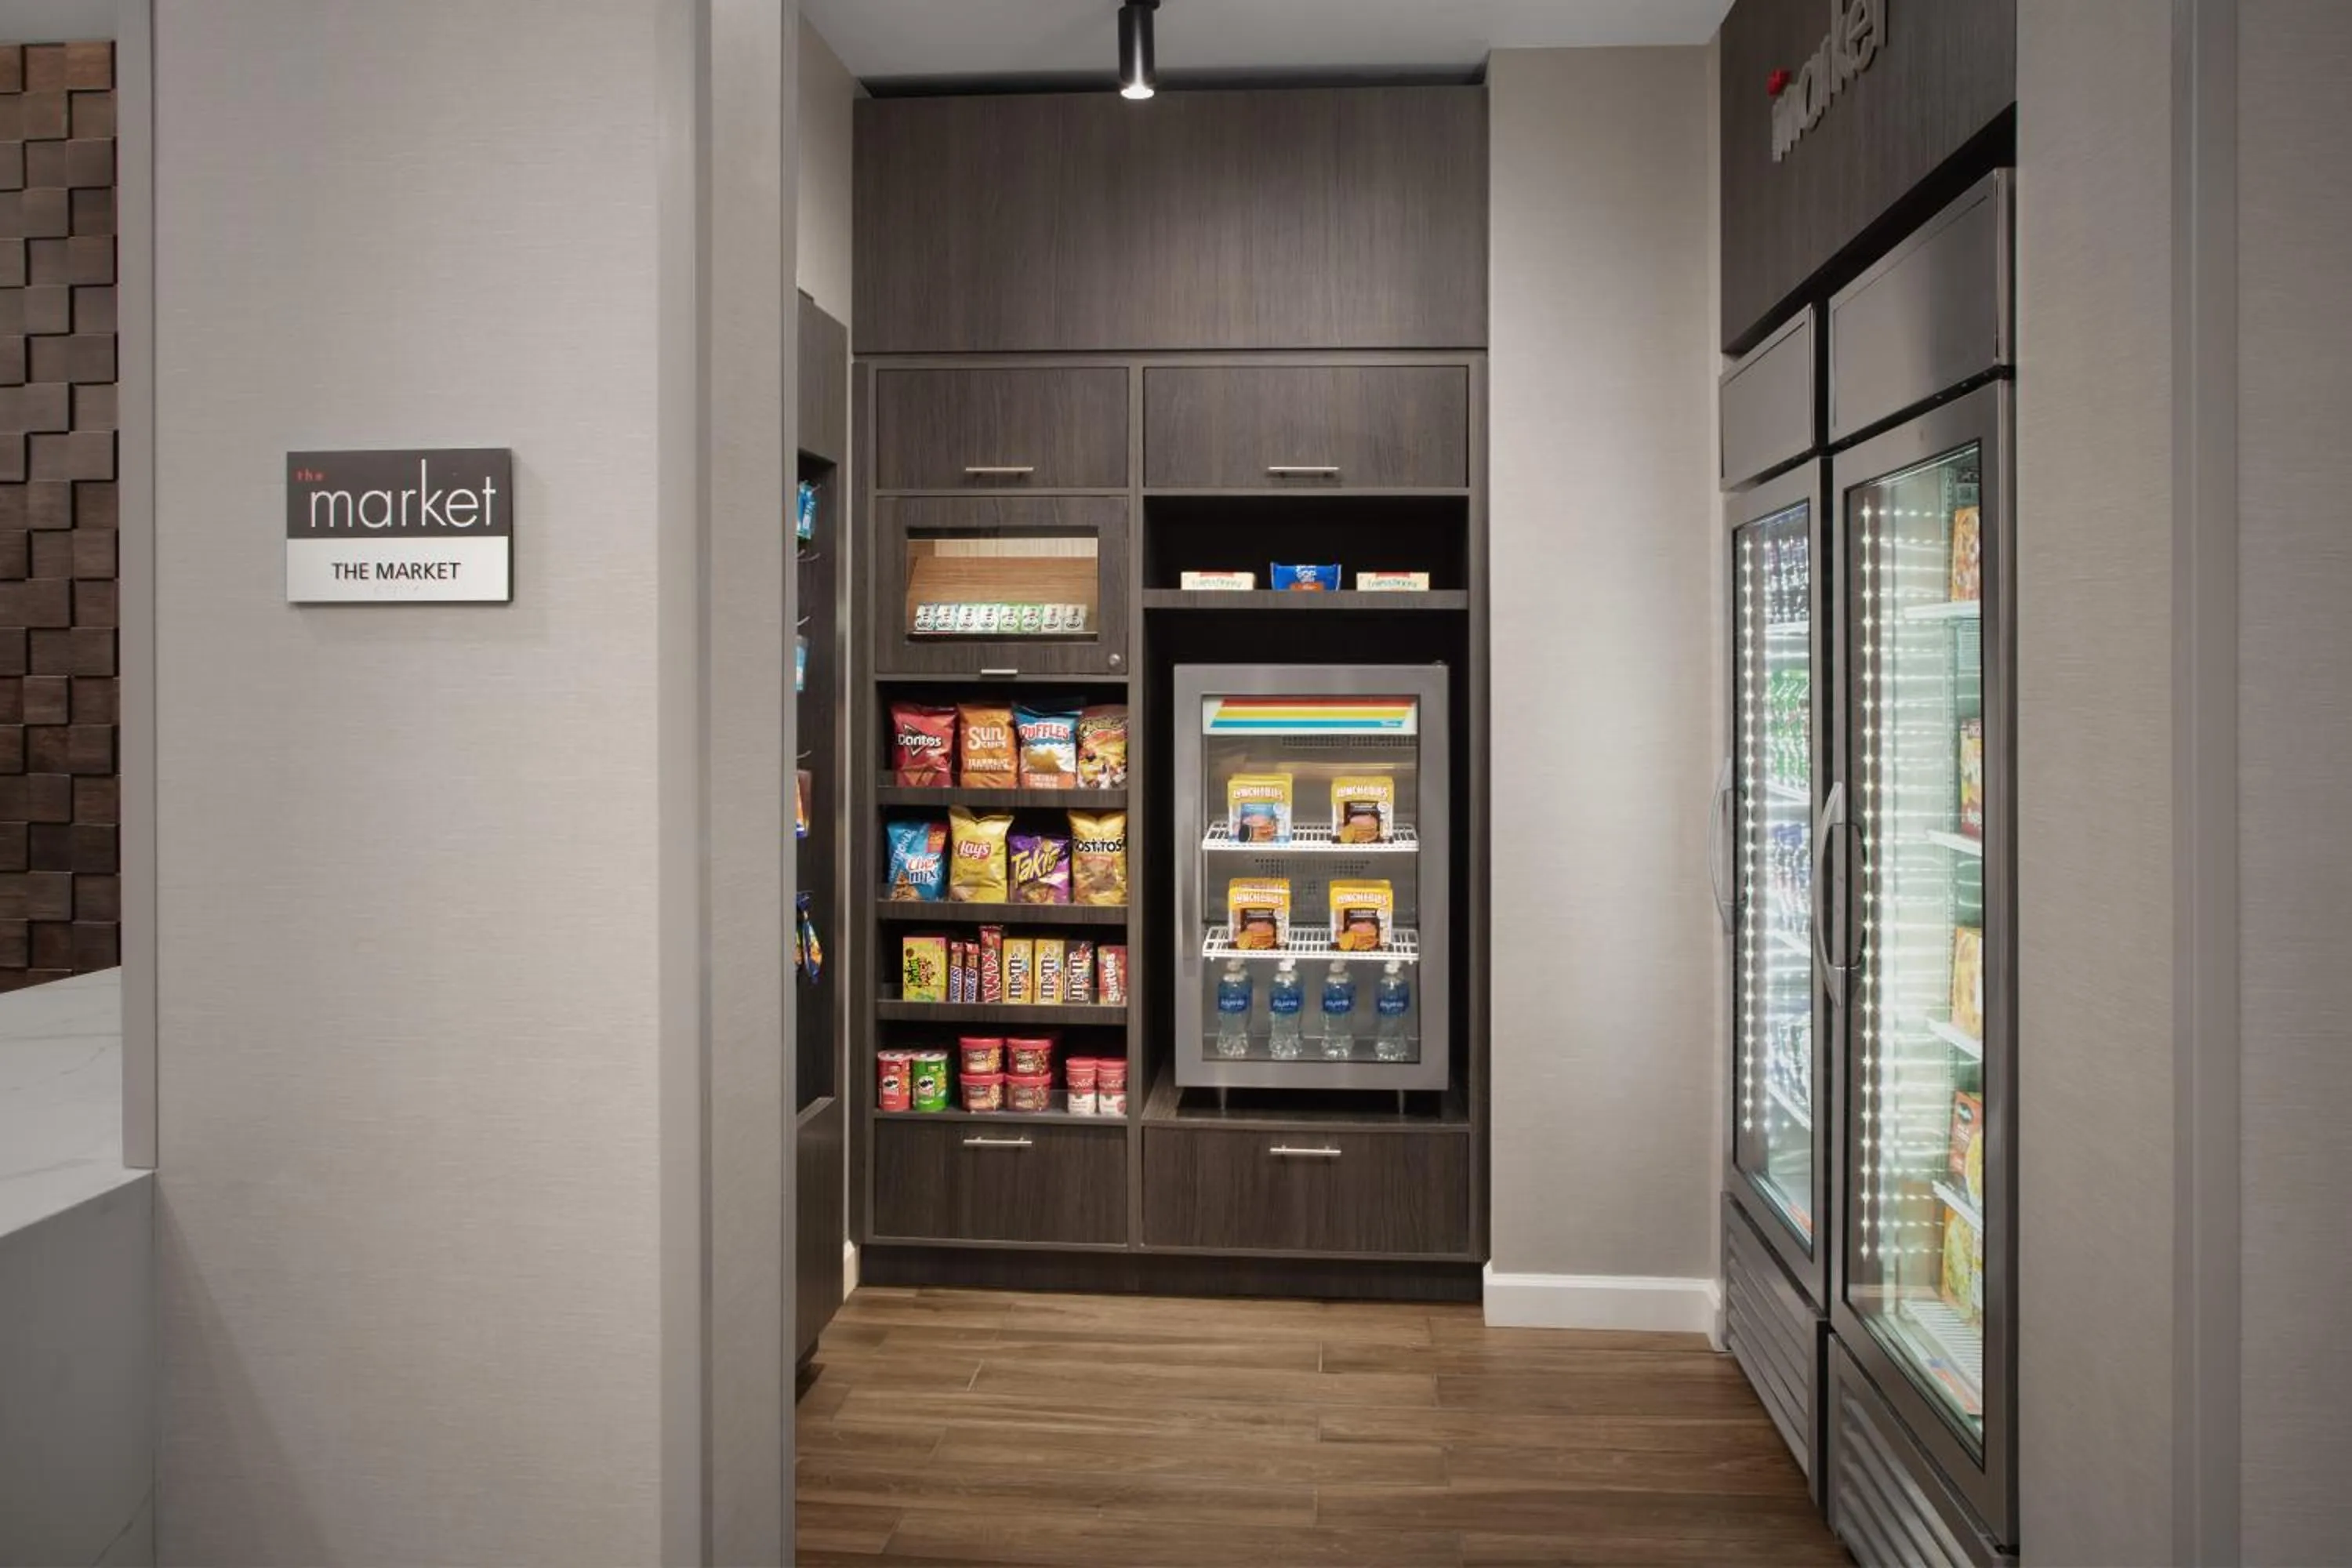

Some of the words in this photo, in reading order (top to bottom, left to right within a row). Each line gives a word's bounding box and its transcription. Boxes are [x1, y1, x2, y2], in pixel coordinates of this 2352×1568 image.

[296, 468, 324, 481] the
[310, 458, 497, 528] market
[332, 562, 369, 580] THE
[376, 562, 461, 580] MARKET
[898, 733, 942, 747] Doritos
